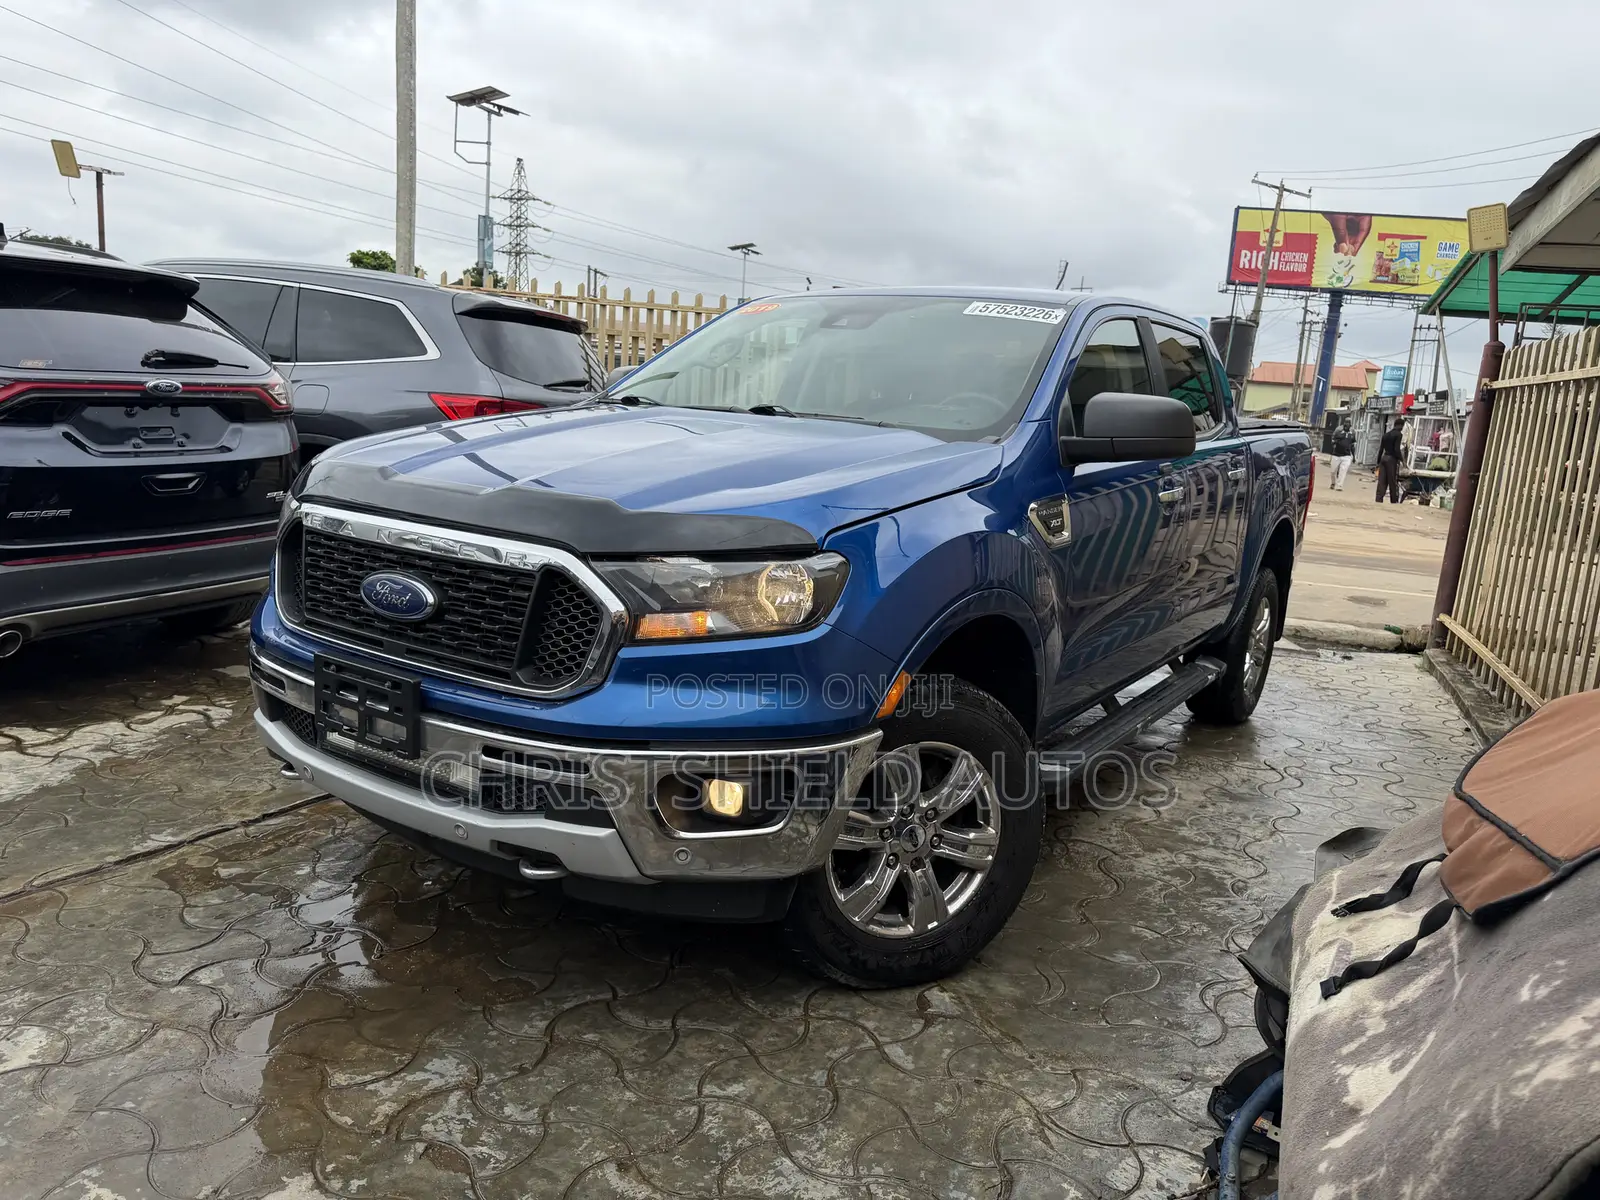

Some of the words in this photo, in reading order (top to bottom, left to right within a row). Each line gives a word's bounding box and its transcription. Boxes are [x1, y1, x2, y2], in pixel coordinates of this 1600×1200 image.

[1281, 251, 1309, 263] CHICKEN
[1279, 261, 1307, 273] FLAVOUR
[6, 508, 73, 519] EDGE
[371, 579, 412, 610] Ford
